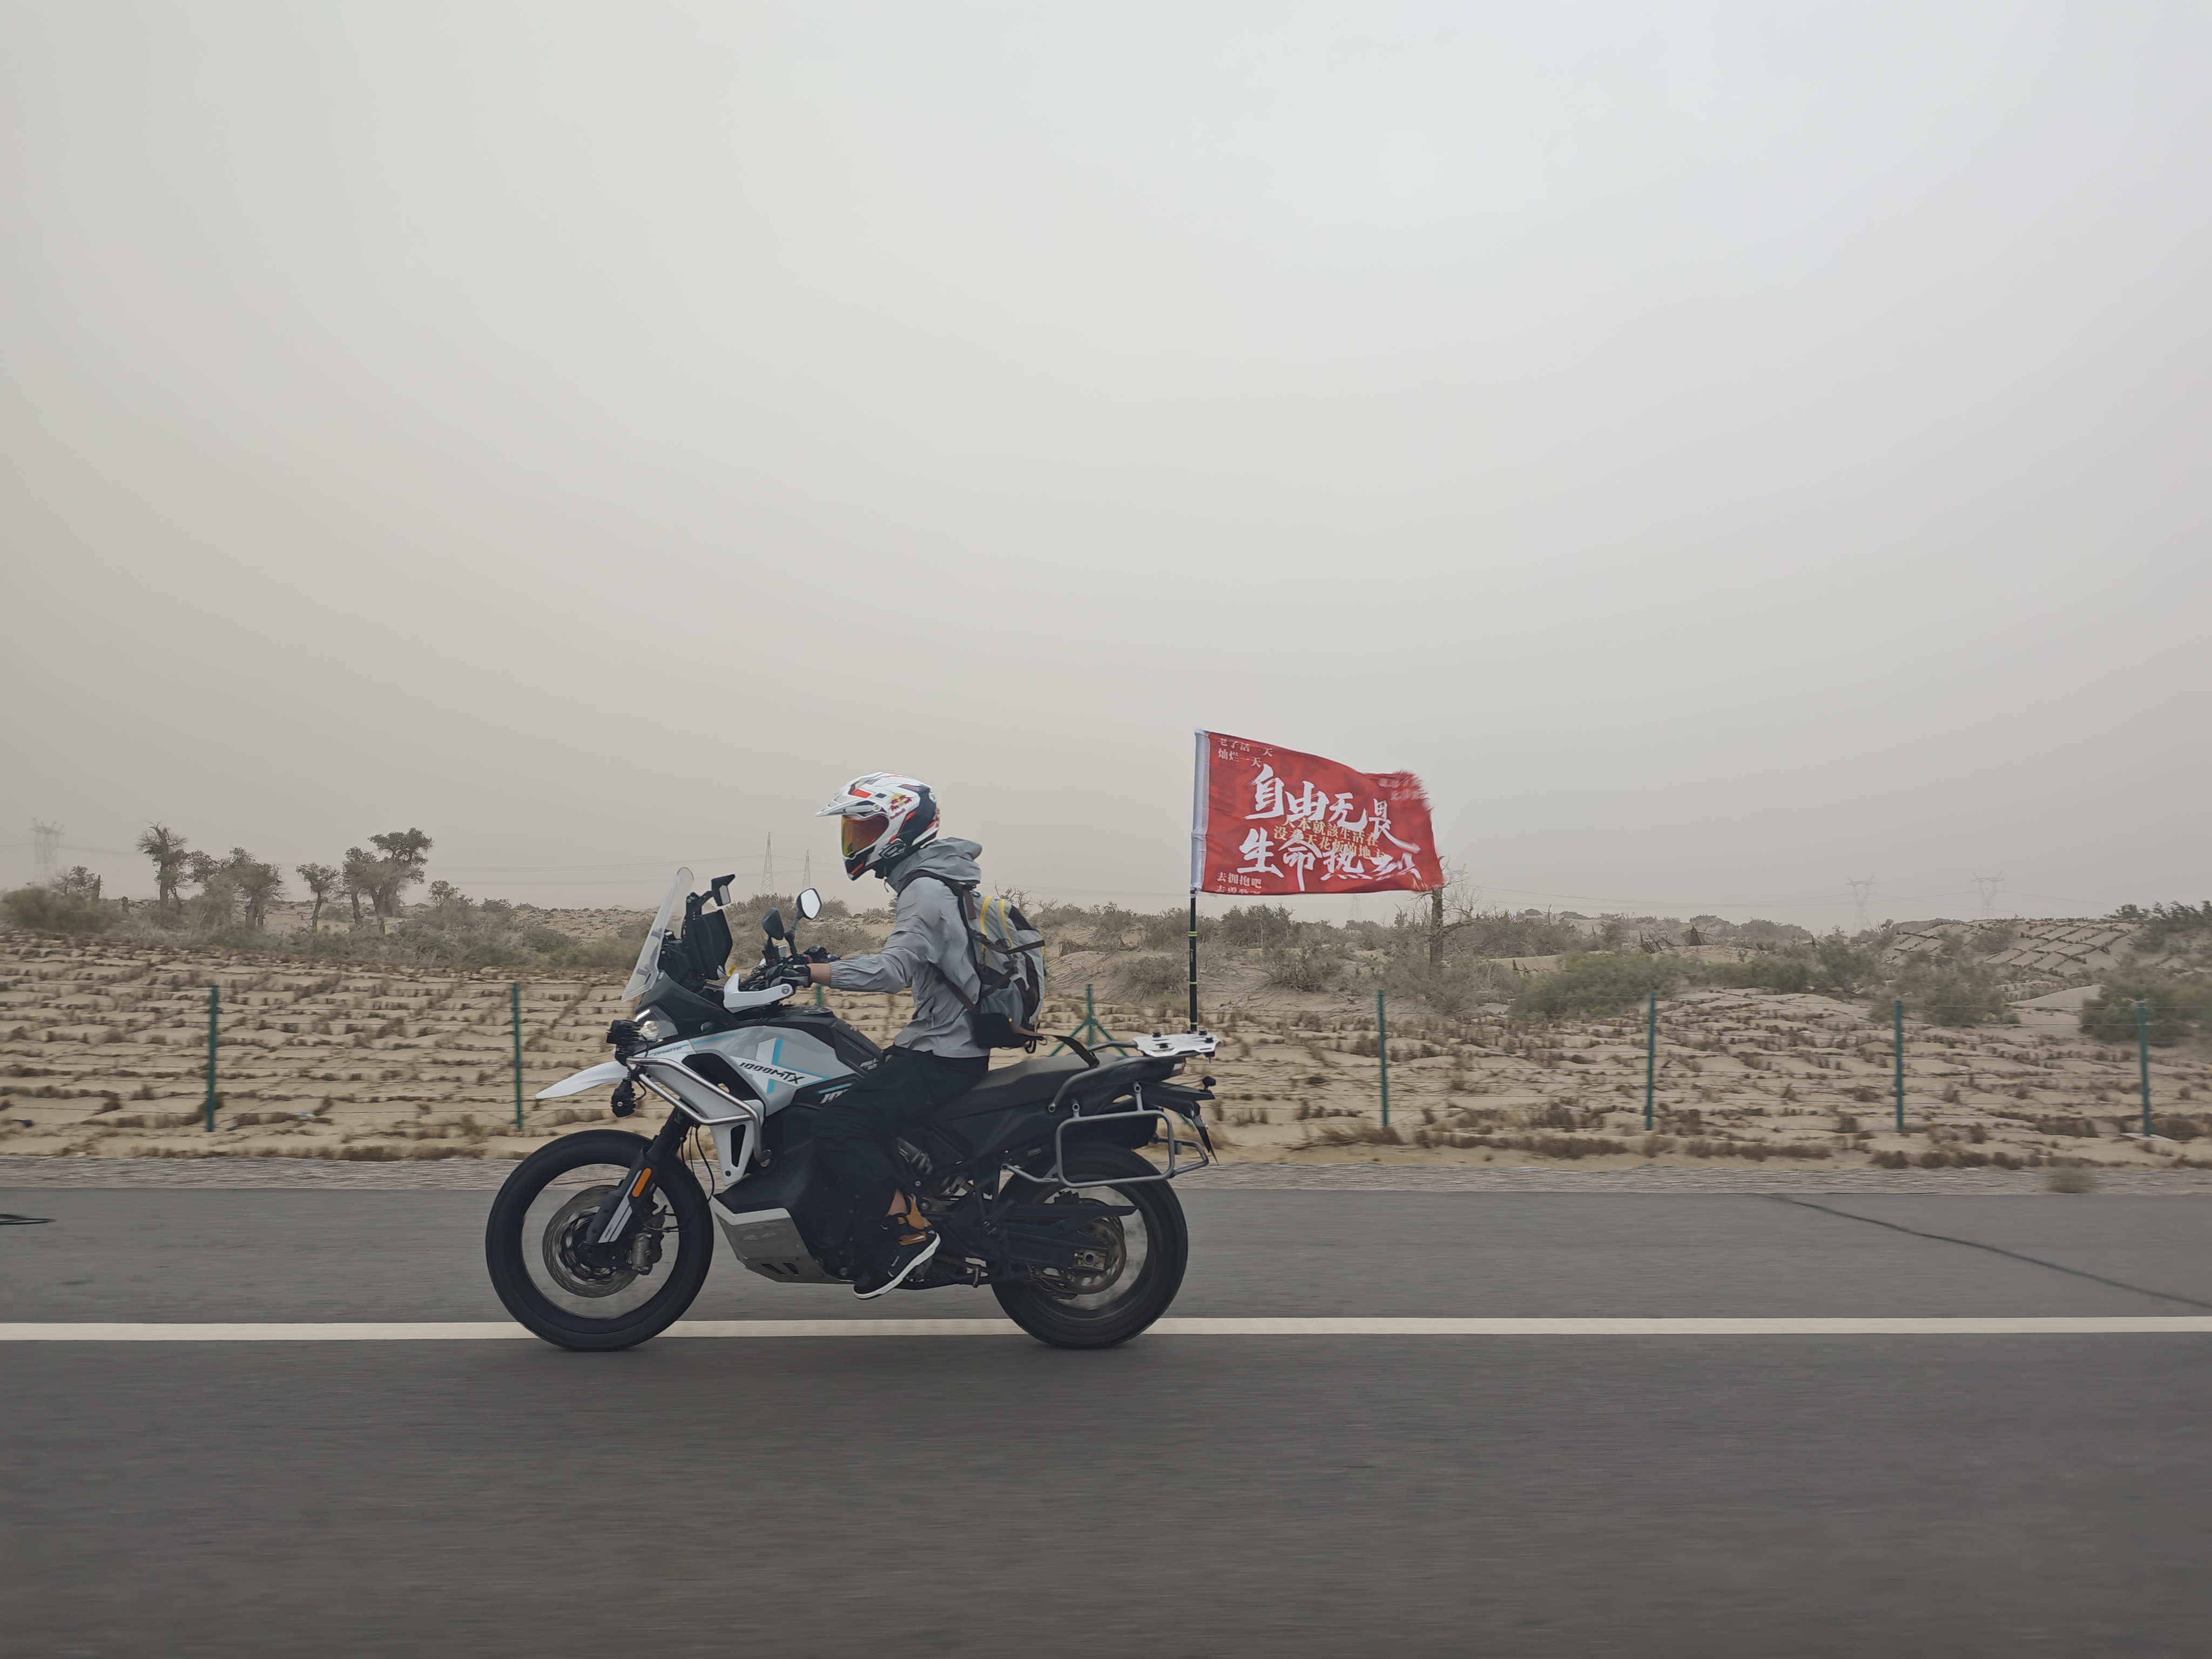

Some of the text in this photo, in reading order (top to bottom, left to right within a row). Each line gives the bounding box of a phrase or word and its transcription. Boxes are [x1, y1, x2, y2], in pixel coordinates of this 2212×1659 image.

[1218, 748, 1262, 768] 灿烂一天
[1242, 764, 1421, 854] 自由无畏
[1217, 871, 1262, 889] 去拥抱吧
